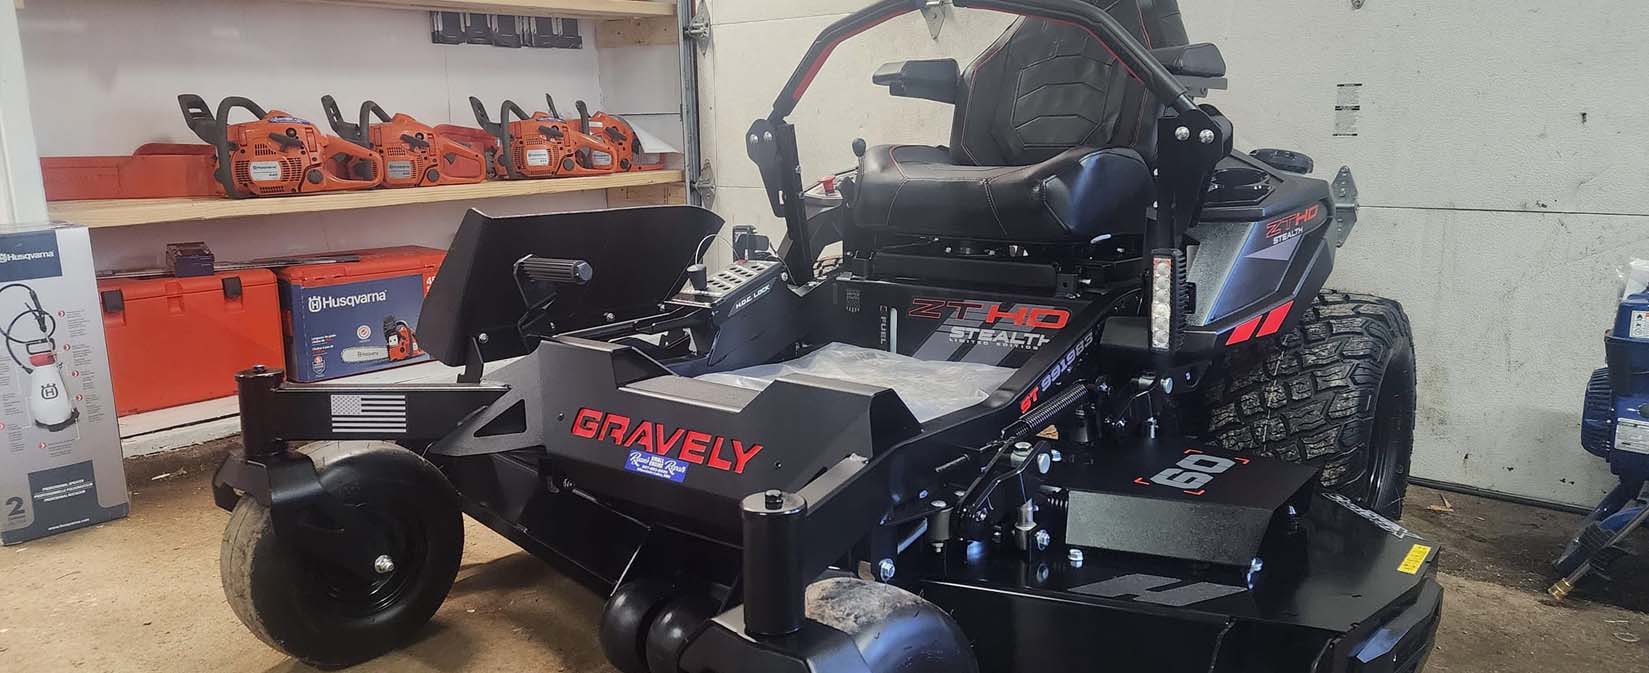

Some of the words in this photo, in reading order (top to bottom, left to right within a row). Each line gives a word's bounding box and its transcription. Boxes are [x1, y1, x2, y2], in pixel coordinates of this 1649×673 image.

[1272, 226, 1303, 245] STEALTH
[7, 251, 54, 261] Husqvarna
[322, 290, 387, 310] Husqvarna
[753, 283, 770, 298] LOCK
[949, 338, 989, 346] LIMITED
[996, 340, 1039, 351] EDITION
[1041, 330, 1094, 392] 991983
[571, 407, 764, 475] GRAVELY
[1150, 454, 1237, 489] 60
[6, 496, 25, 517] 2
